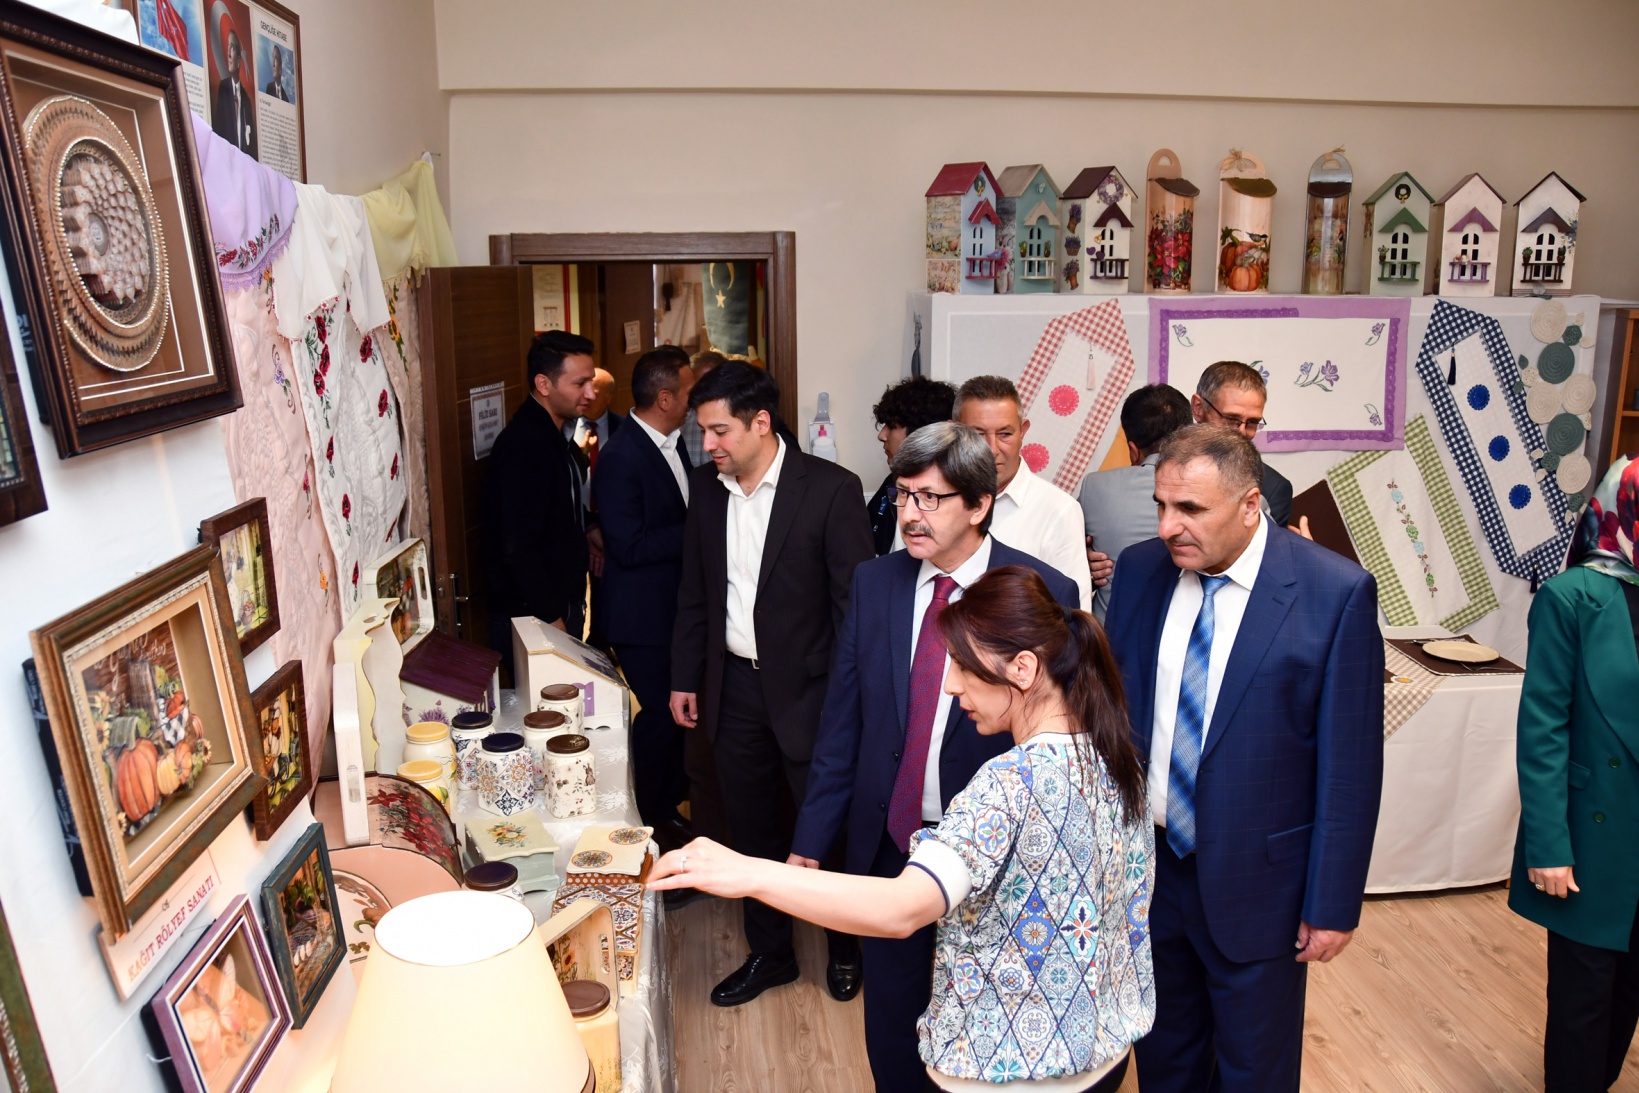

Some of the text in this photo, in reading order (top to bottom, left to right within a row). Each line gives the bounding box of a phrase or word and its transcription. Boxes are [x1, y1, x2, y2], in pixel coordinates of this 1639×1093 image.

[127, 875, 214, 983] KAĞIT RÖLYEF SANATI
